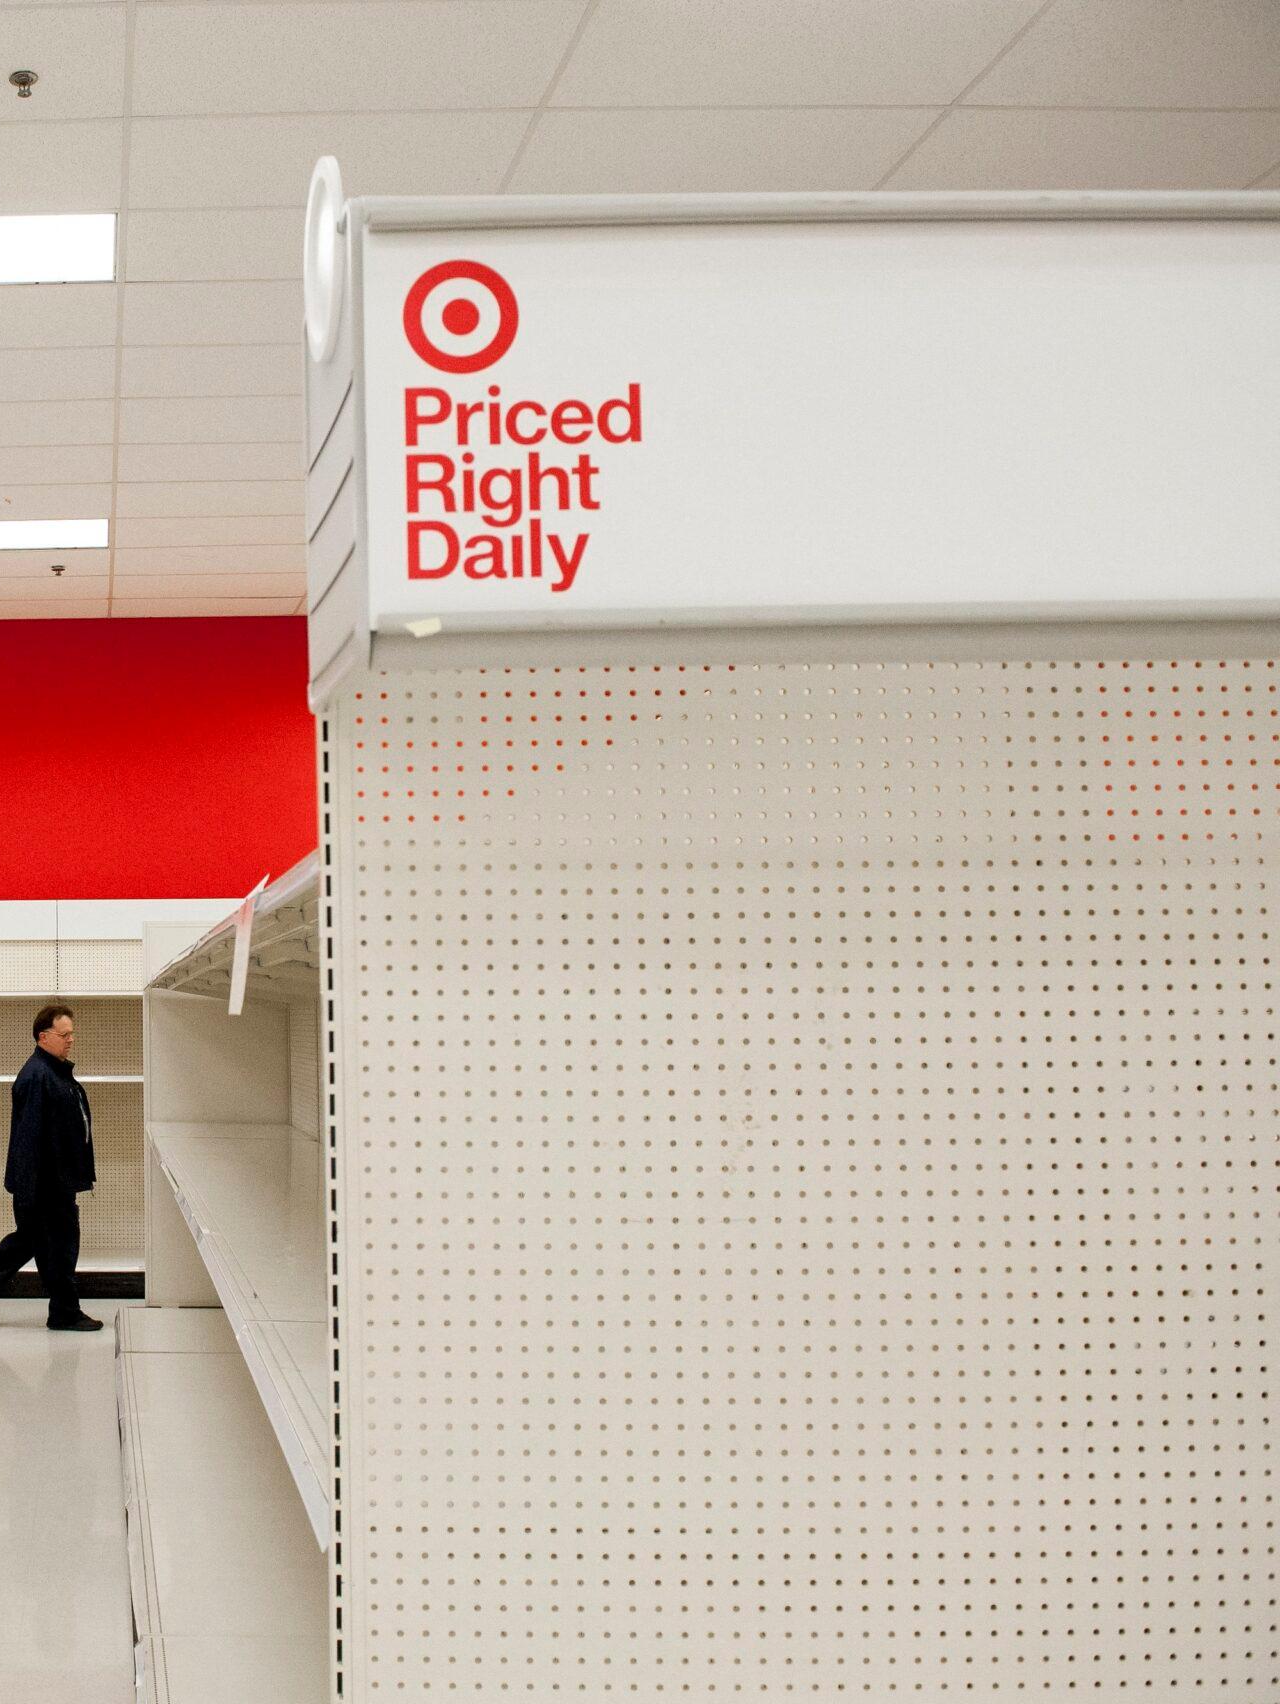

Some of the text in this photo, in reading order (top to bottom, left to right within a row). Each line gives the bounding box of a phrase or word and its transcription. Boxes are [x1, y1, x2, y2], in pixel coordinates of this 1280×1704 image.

[404, 383, 642, 447] Priced
[405, 452, 601, 529] Right
[406, 517, 590, 593] Daily
